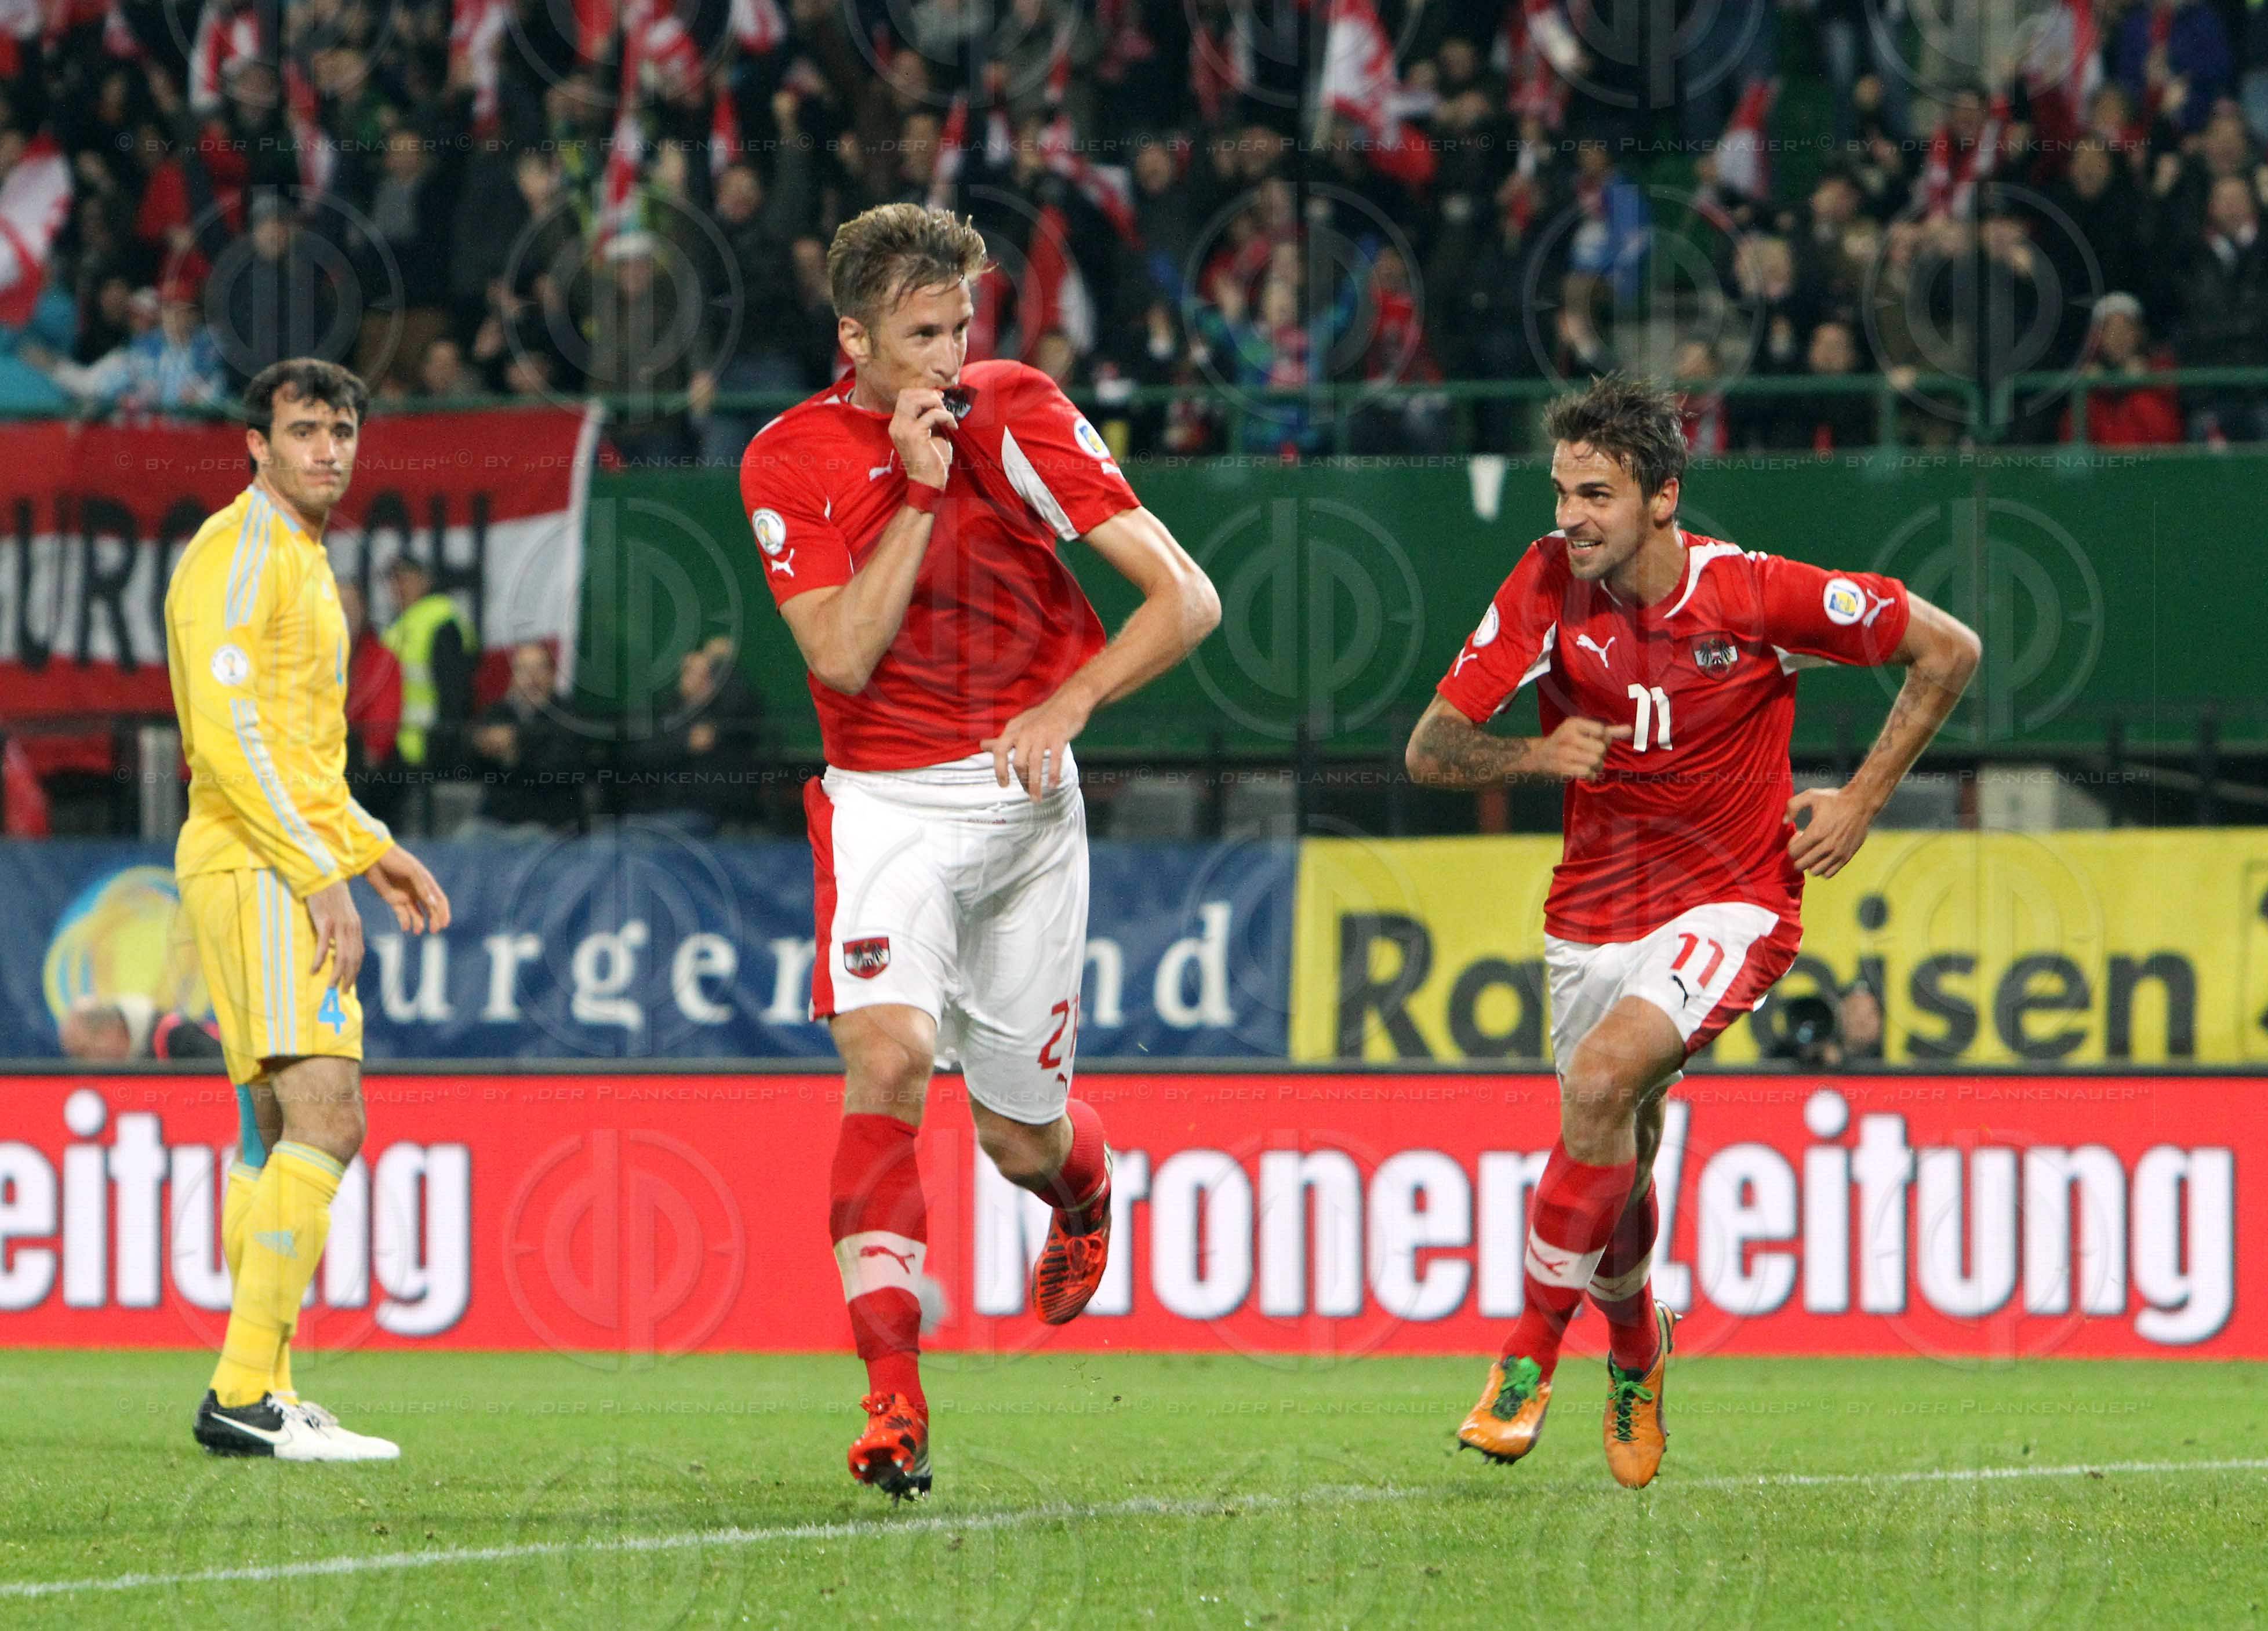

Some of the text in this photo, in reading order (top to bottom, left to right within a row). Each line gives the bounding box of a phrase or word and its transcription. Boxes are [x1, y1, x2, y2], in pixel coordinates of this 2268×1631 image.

[1627, 683, 1673, 752] 11
[1670, 932, 1725, 990] 11
[317, 986, 347, 1035] 4
